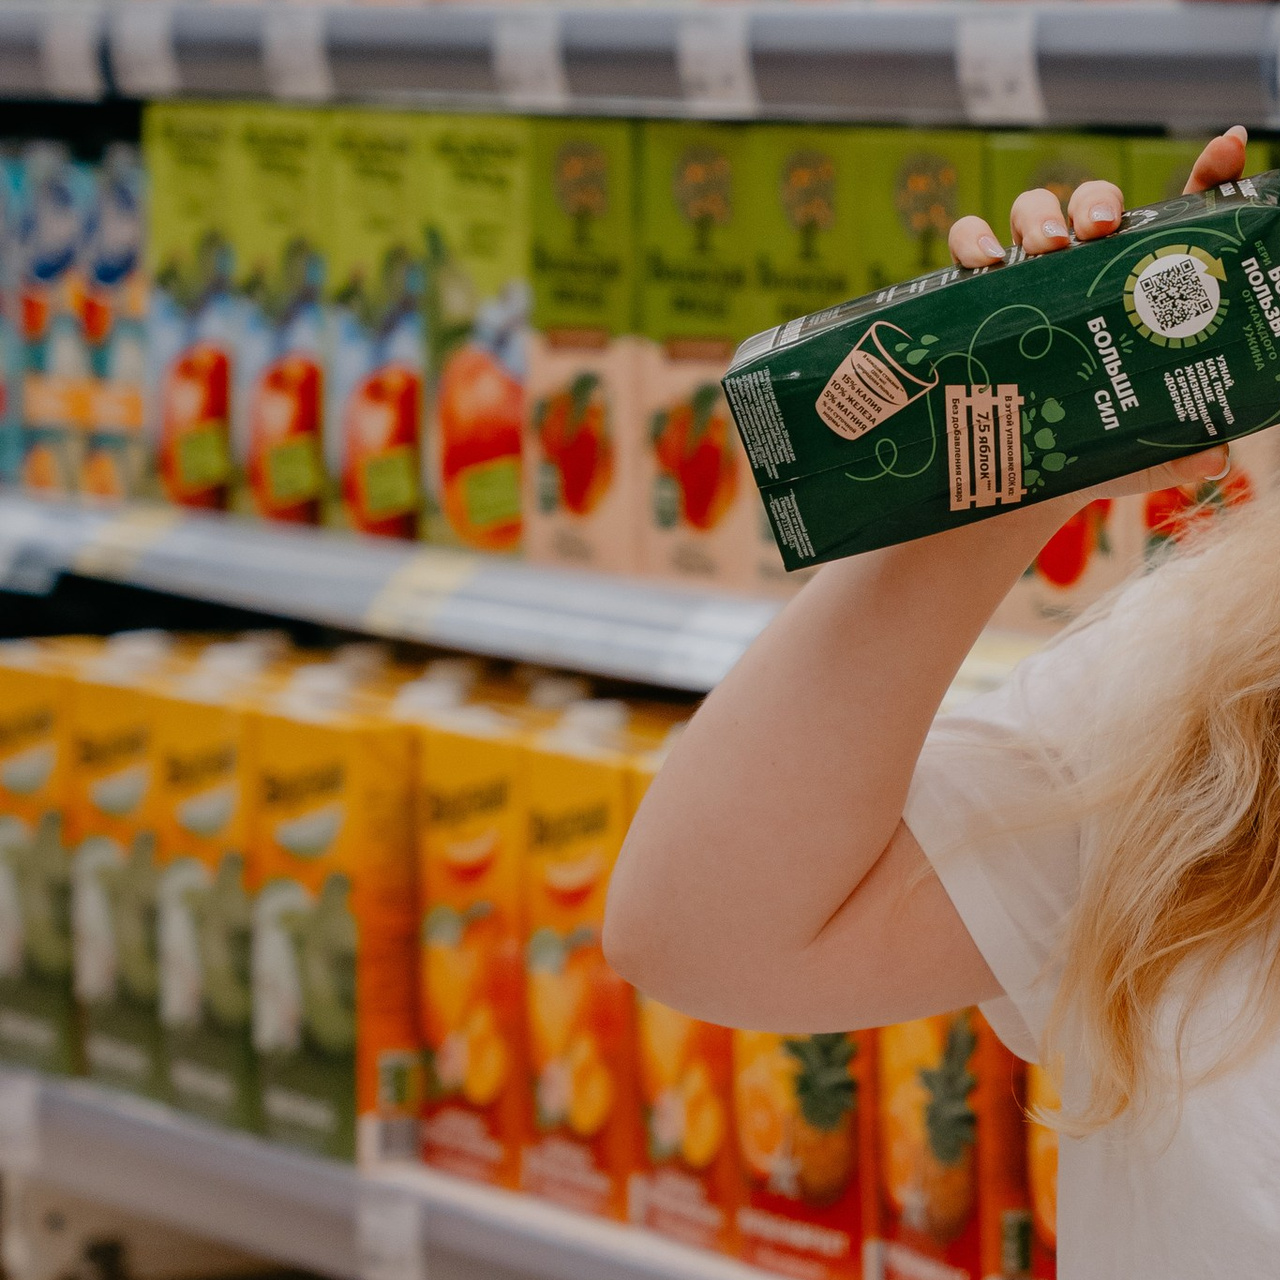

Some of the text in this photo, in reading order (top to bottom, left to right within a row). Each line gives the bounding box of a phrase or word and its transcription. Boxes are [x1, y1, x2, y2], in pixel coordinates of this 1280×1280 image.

[1253, 240, 1272, 266] БЕРИ
[1241, 288, 1277, 360] ОТ КАЖДОГО
[1086, 316, 1139, 411] БОЛЬШЕ
[1241, 324, 1266, 371] УЖИНА
[1194, 361, 1214, 403] БОЛЬШЕ
[1205, 358, 1235, 425] КАК ПОЛУЧИТЬ
[1215, 354, 1233, 390] УЗНАЙ,
[823, 390, 868, 432] 5% МАГНИЯ
[830, 379, 877, 425] 10% ЖЕЛЕЗА
[841, 373, 883, 414] 15% КАЛИЯ
[1004, 403, 1014, 426] этой
[1092, 388, 1119, 430] СИЛ
[1162, 370, 1188, 422] «ДОБРЫЙ»
[1173, 367, 1198, 421] С БРЕНДОМ
[1184, 364, 1216, 436] ЖИЗНЕННЫХ СИЛ
[975, 412, 990, 432] 7,5
[951, 398, 962, 502] Без добавления сахара
[1004, 429, 1013, 471] упаковке
[1007, 472, 1015, 486] СОК
